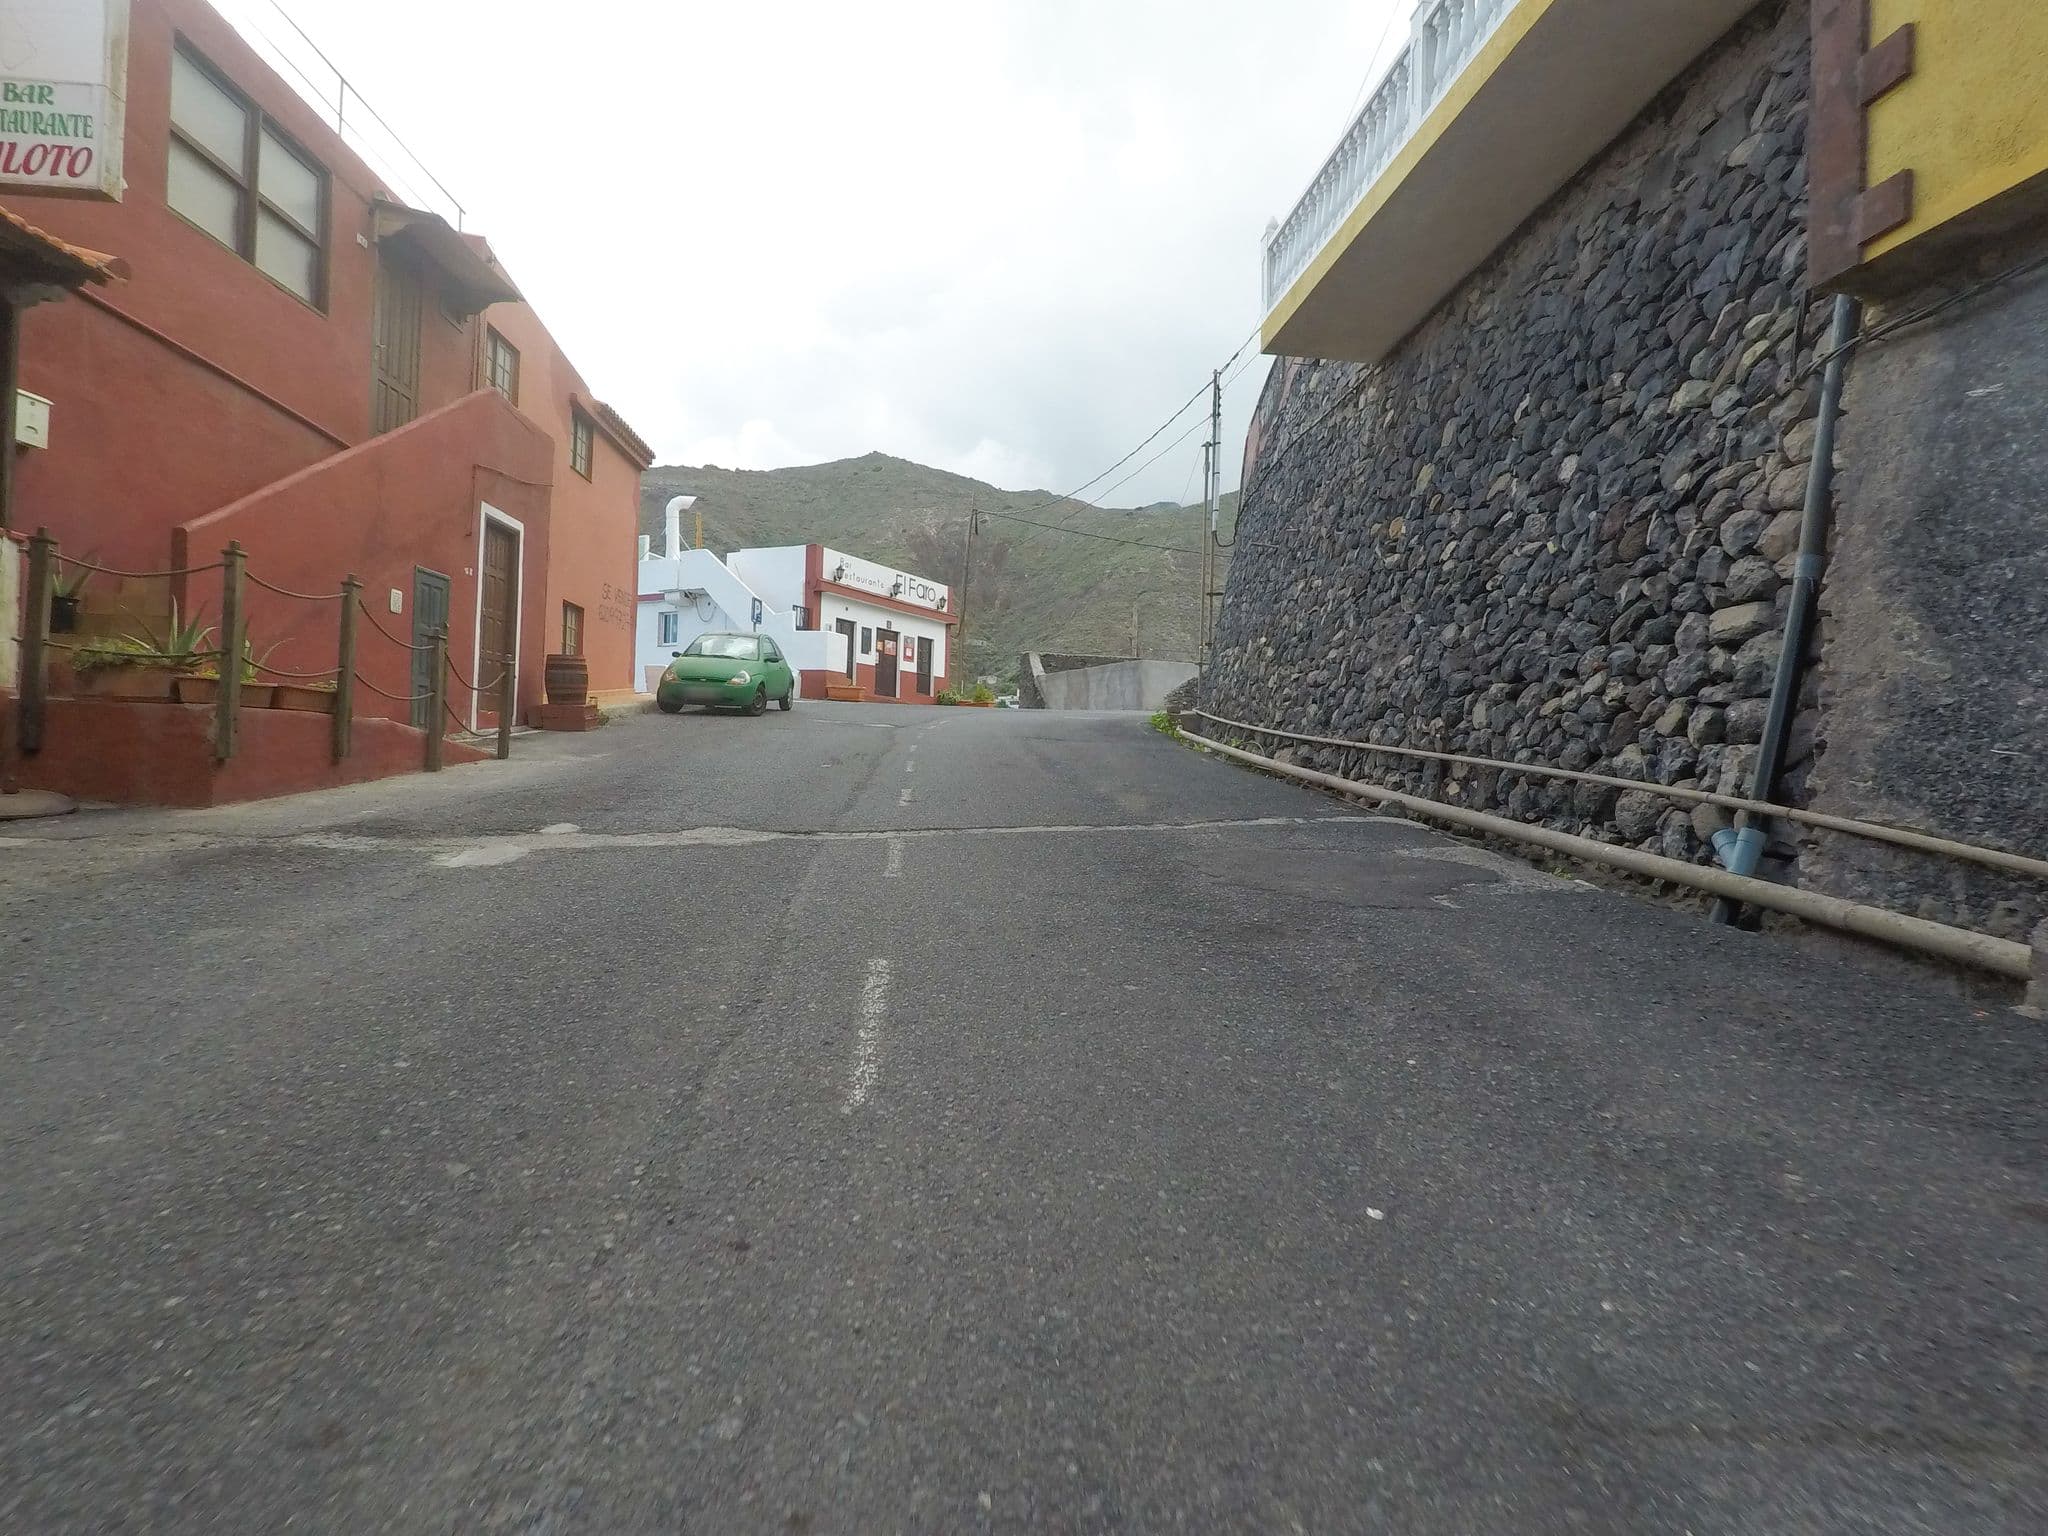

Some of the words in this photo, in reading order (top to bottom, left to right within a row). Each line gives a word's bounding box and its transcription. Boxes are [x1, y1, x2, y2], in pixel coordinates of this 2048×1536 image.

[3, 82, 54, 105] BAR
[843, 571, 885, 589] estaurante
[895, 574, 906, 595] El
[908, 577, 937, 602] Faro
